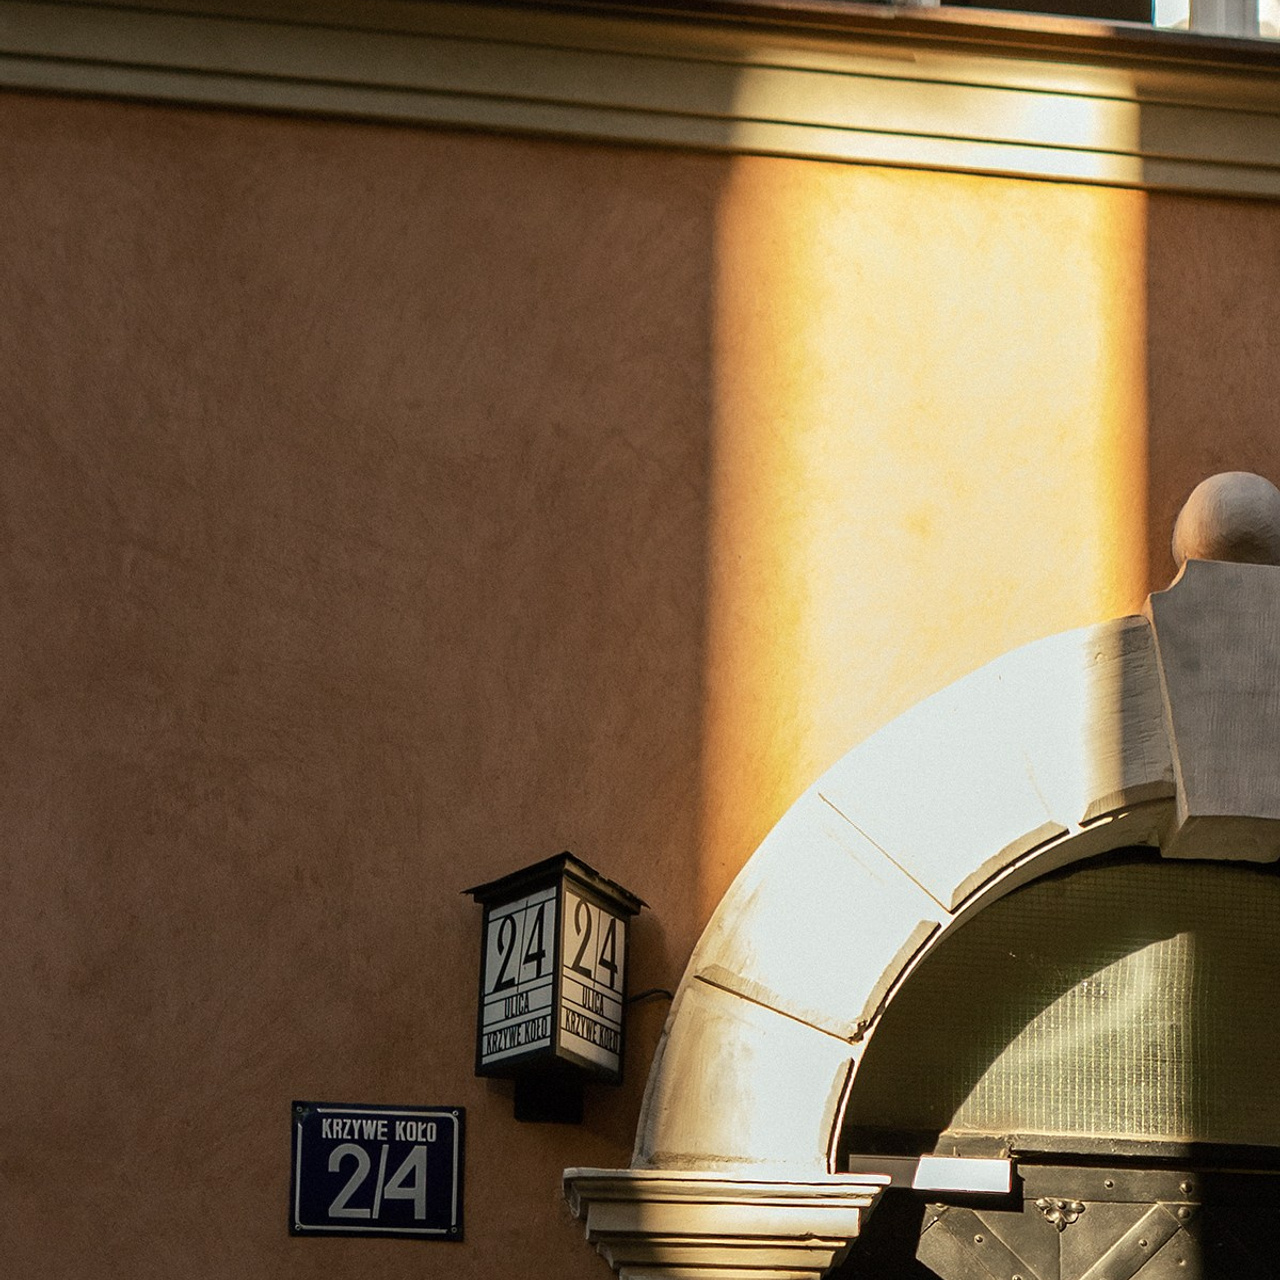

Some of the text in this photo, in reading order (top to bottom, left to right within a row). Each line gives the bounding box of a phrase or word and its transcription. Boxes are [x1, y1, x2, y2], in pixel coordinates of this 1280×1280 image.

[504, 992, 529, 1019] ULICA
[582, 985, 604, 1016] ULICA
[487, 1023, 521, 1055] KRZYWE
[565, 1009, 597, 1043] KRZYWE
[322, 1118, 437, 1142] KRZYWE KOŁO
[328, 1143, 427, 1220] 2/4
